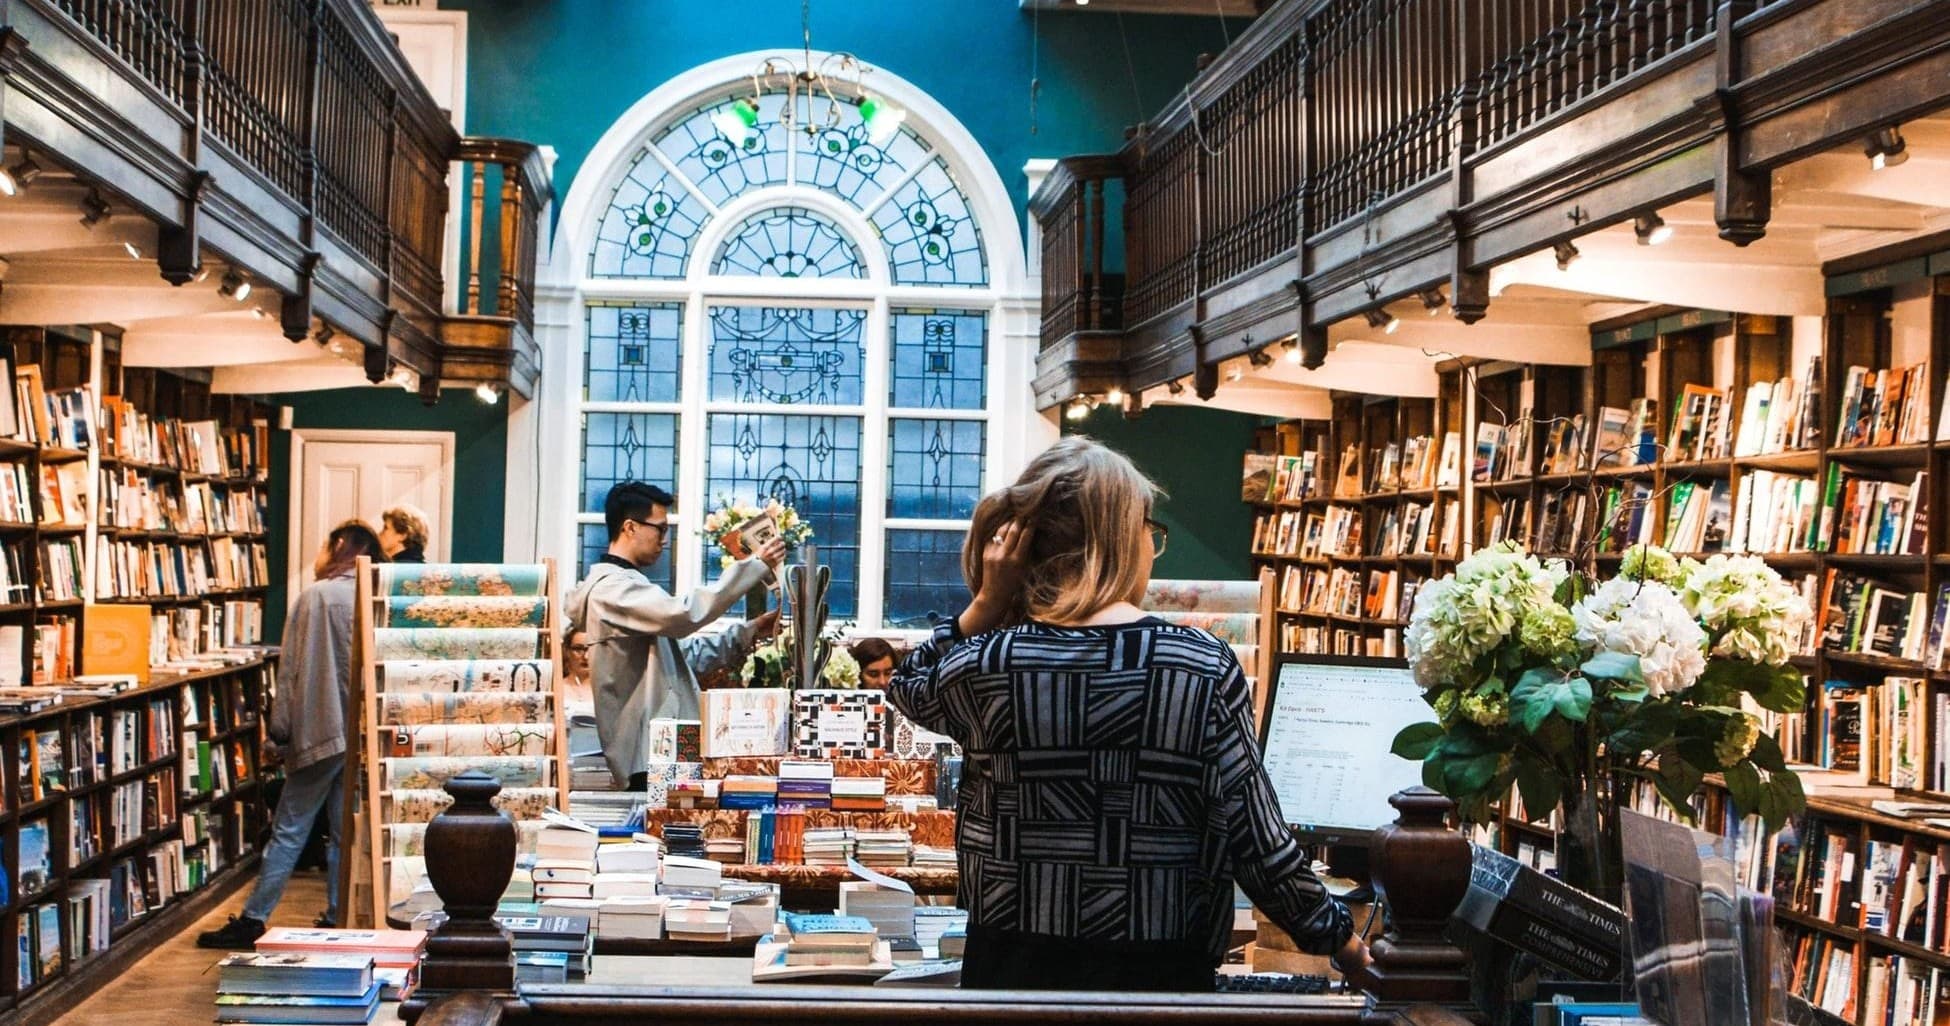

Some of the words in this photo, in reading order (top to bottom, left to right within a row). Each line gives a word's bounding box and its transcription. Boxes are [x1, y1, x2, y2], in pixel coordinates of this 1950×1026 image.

[1542, 890, 1564, 907] THE
[1589, 913, 1622, 935] TIMES
[1528, 922, 1552, 941] THE
[1576, 945, 1610, 969] TIMES
